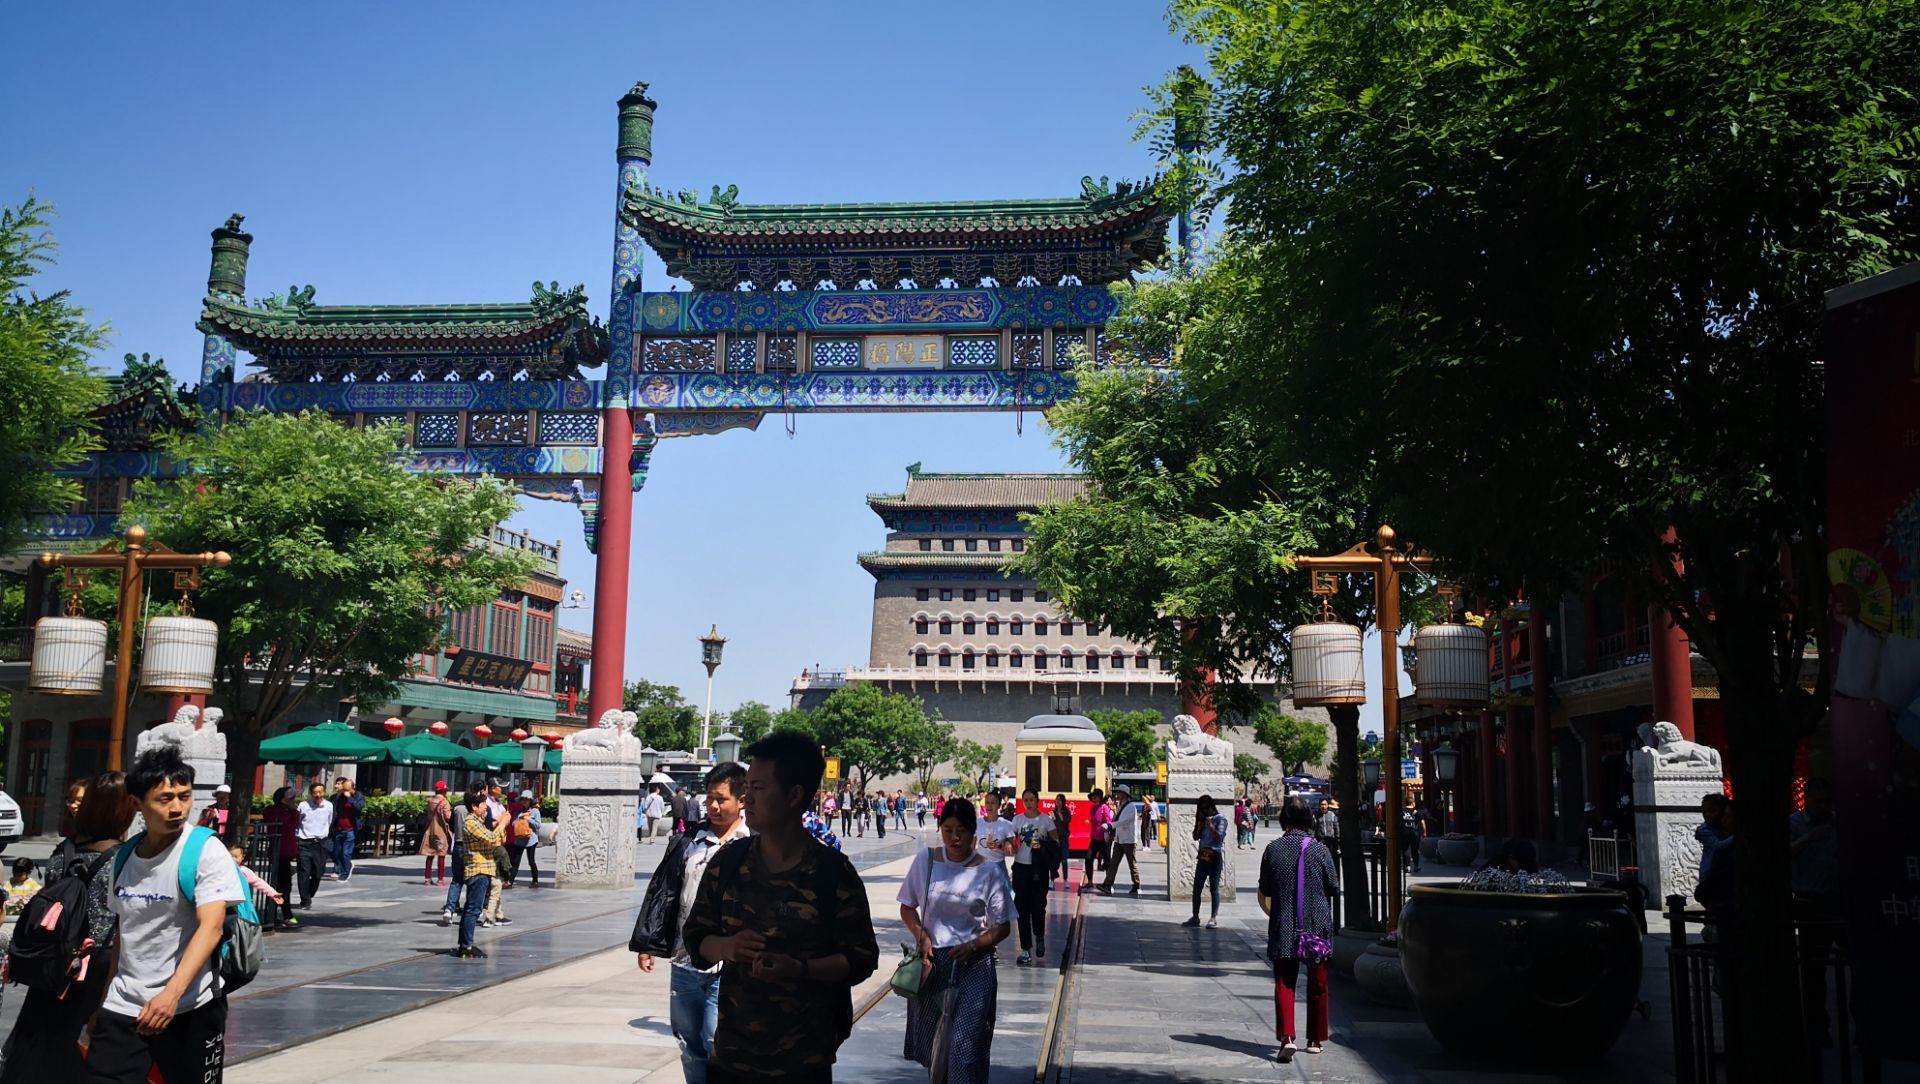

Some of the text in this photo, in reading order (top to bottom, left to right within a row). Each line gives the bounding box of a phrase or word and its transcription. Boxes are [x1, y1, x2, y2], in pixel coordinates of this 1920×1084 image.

[458, 656, 526, 684] 星巴克咖啡
[114, 886, 174, 904] Champion
